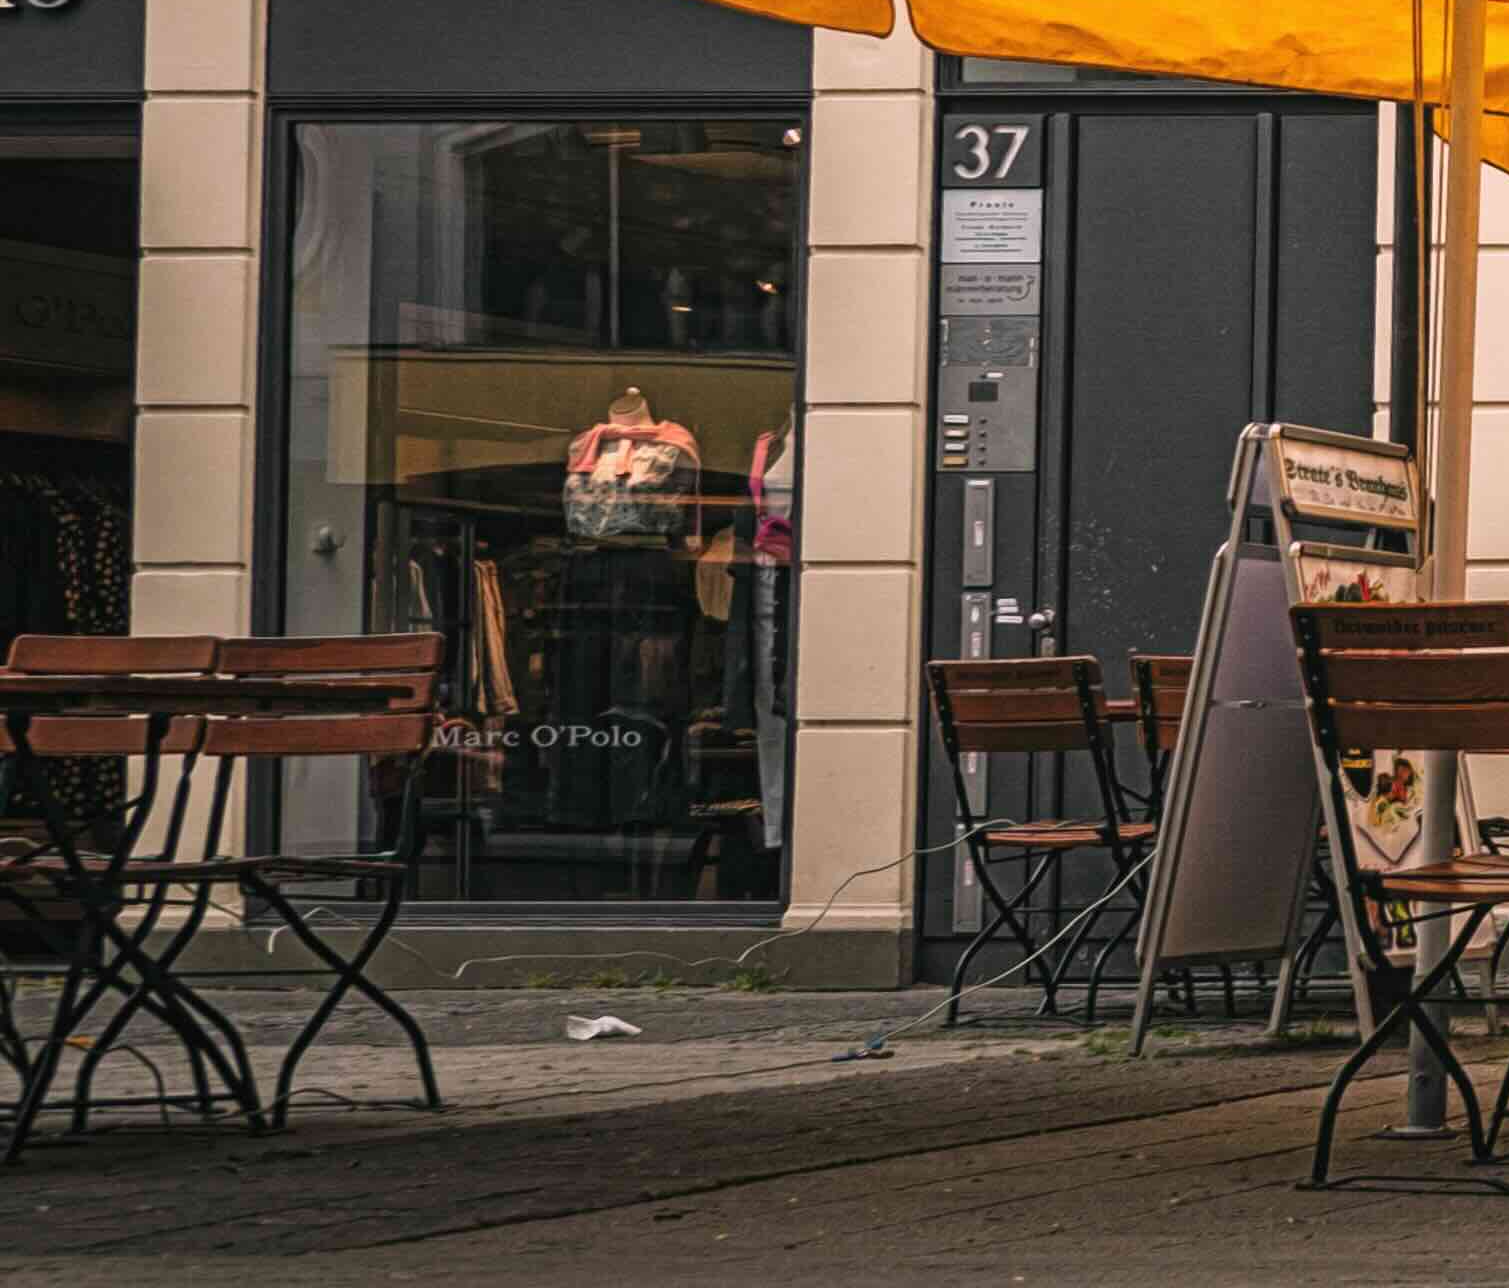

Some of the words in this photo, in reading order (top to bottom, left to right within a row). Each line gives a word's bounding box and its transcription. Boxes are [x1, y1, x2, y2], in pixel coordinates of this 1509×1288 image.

[953, 124, 1030, 179] 37
[432, 722, 523, 749] Marc
[530, 722, 643, 749] O'Polo
